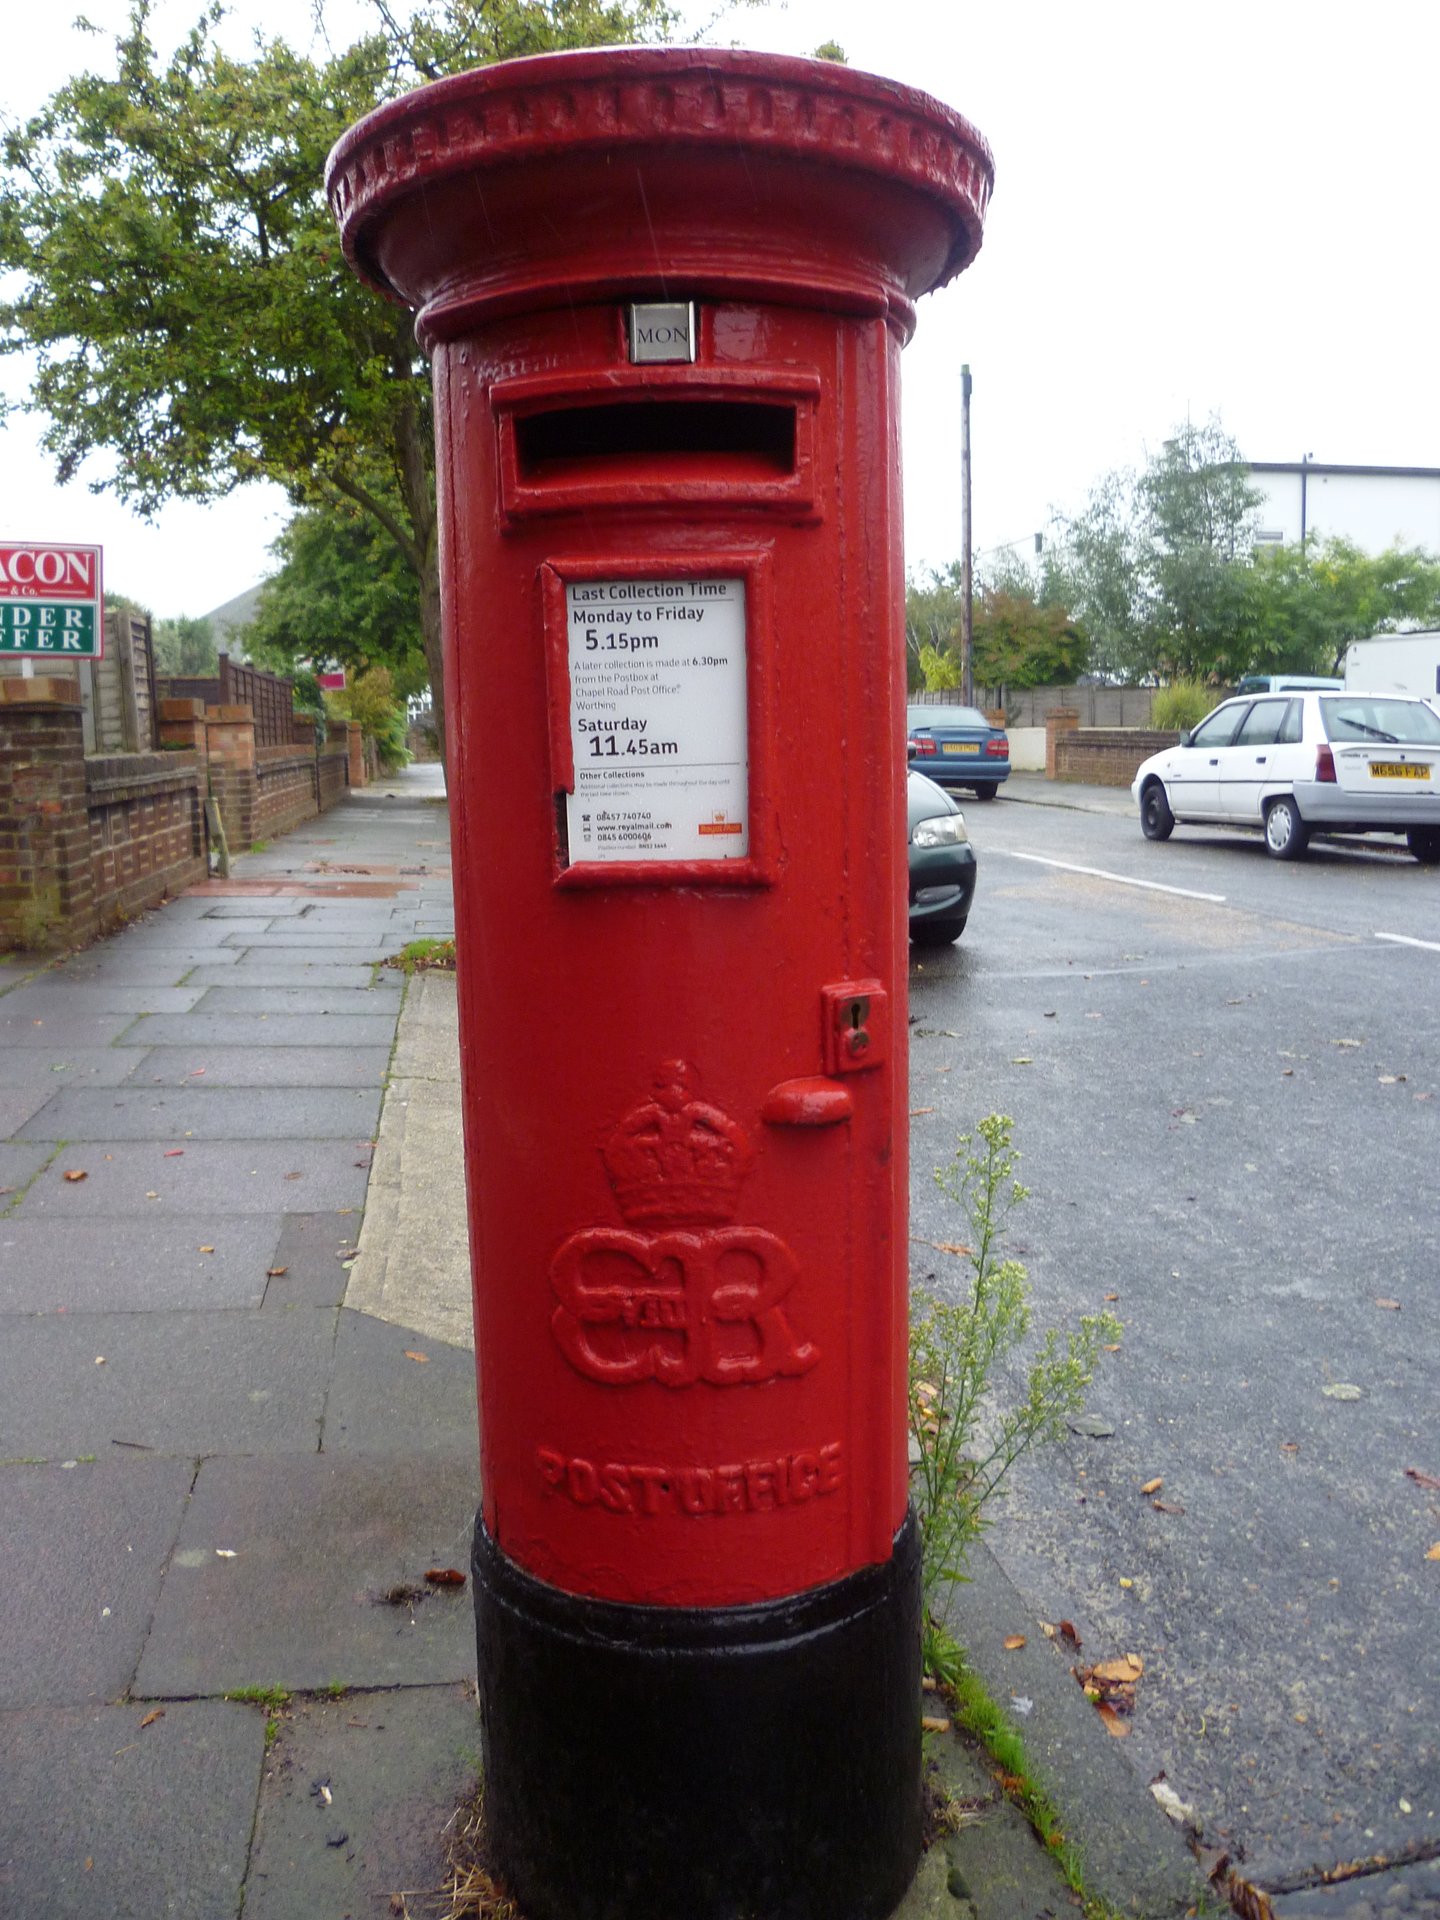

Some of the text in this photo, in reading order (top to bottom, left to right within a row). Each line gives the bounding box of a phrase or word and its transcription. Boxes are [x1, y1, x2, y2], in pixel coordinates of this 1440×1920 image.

[638, 327, 688, 343] MON
[10, 585, 19, 595] &
[572, 581, 727, 601] Last Collection Time
[0, 607, 84, 628] DER
[573, 606, 705, 625] Monday to Friday
[585, 629, 659, 652] 5.15pm
[582, 660, 602, 670] later
[604, 659, 644, 670] collection
[646, 659, 654, 669] is
[655, 658, 680, 668] made
[681, 658, 690, 667] at
[692, 656, 729, 668] 6.30pm
[575, 672, 659, 684] from the Postbox at
[575, 687, 605, 699] Chapel
[606, 685, 629, 696] Road
[631, 685, 650, 695] Post
[576, 700, 617, 712] Worthing
[578, 717, 648, 733] Saturday
[589, 735, 678, 757] 11.45am
[579, 770, 645, 780] Other Collections
[596, 811, 652, 822] 08457 740740
[597, 833, 617, 842] 0845
[536, 1441, 842, 1517] POST OFFICE
